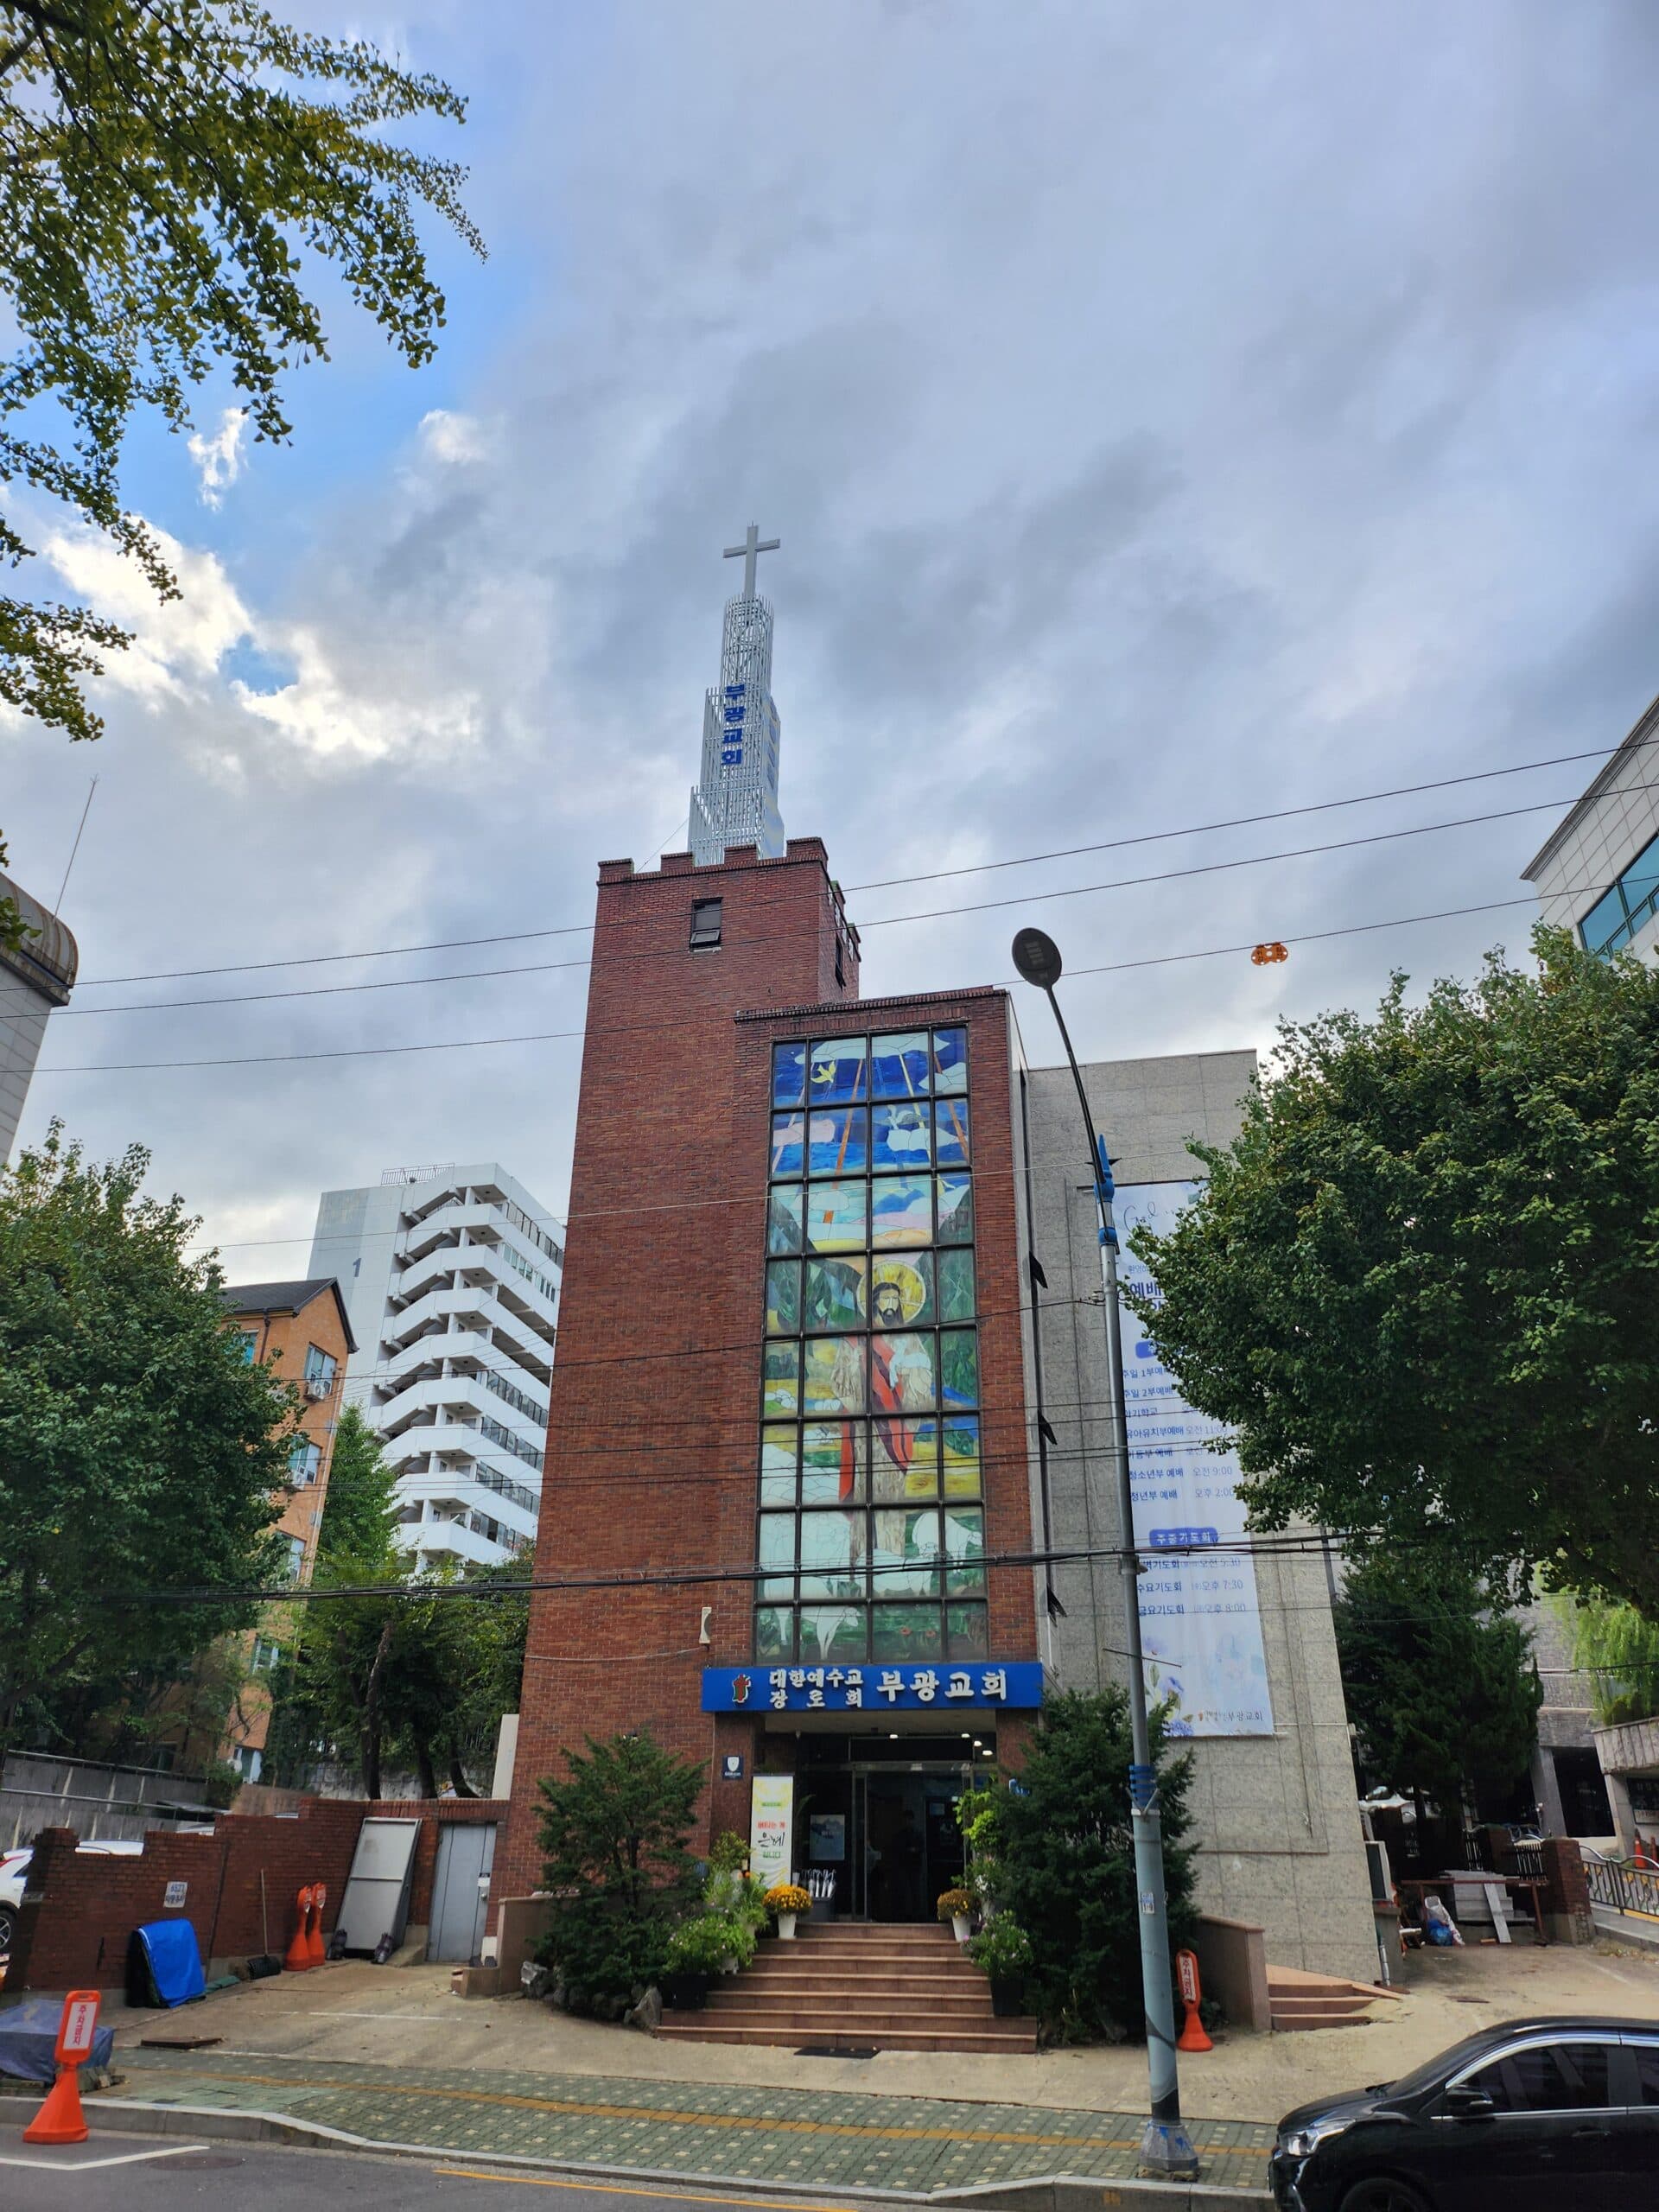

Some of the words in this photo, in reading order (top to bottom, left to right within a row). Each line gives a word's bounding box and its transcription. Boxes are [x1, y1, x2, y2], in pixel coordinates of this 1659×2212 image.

[353, 1257, 362, 1277] 1
[1141, 1367, 1167, 1377] 1부예
[768, 1669, 863, 1688] 대한예수교
[876, 1669, 1007, 1703] 부광교회
[73, 2004, 87, 2046] 주차금지
